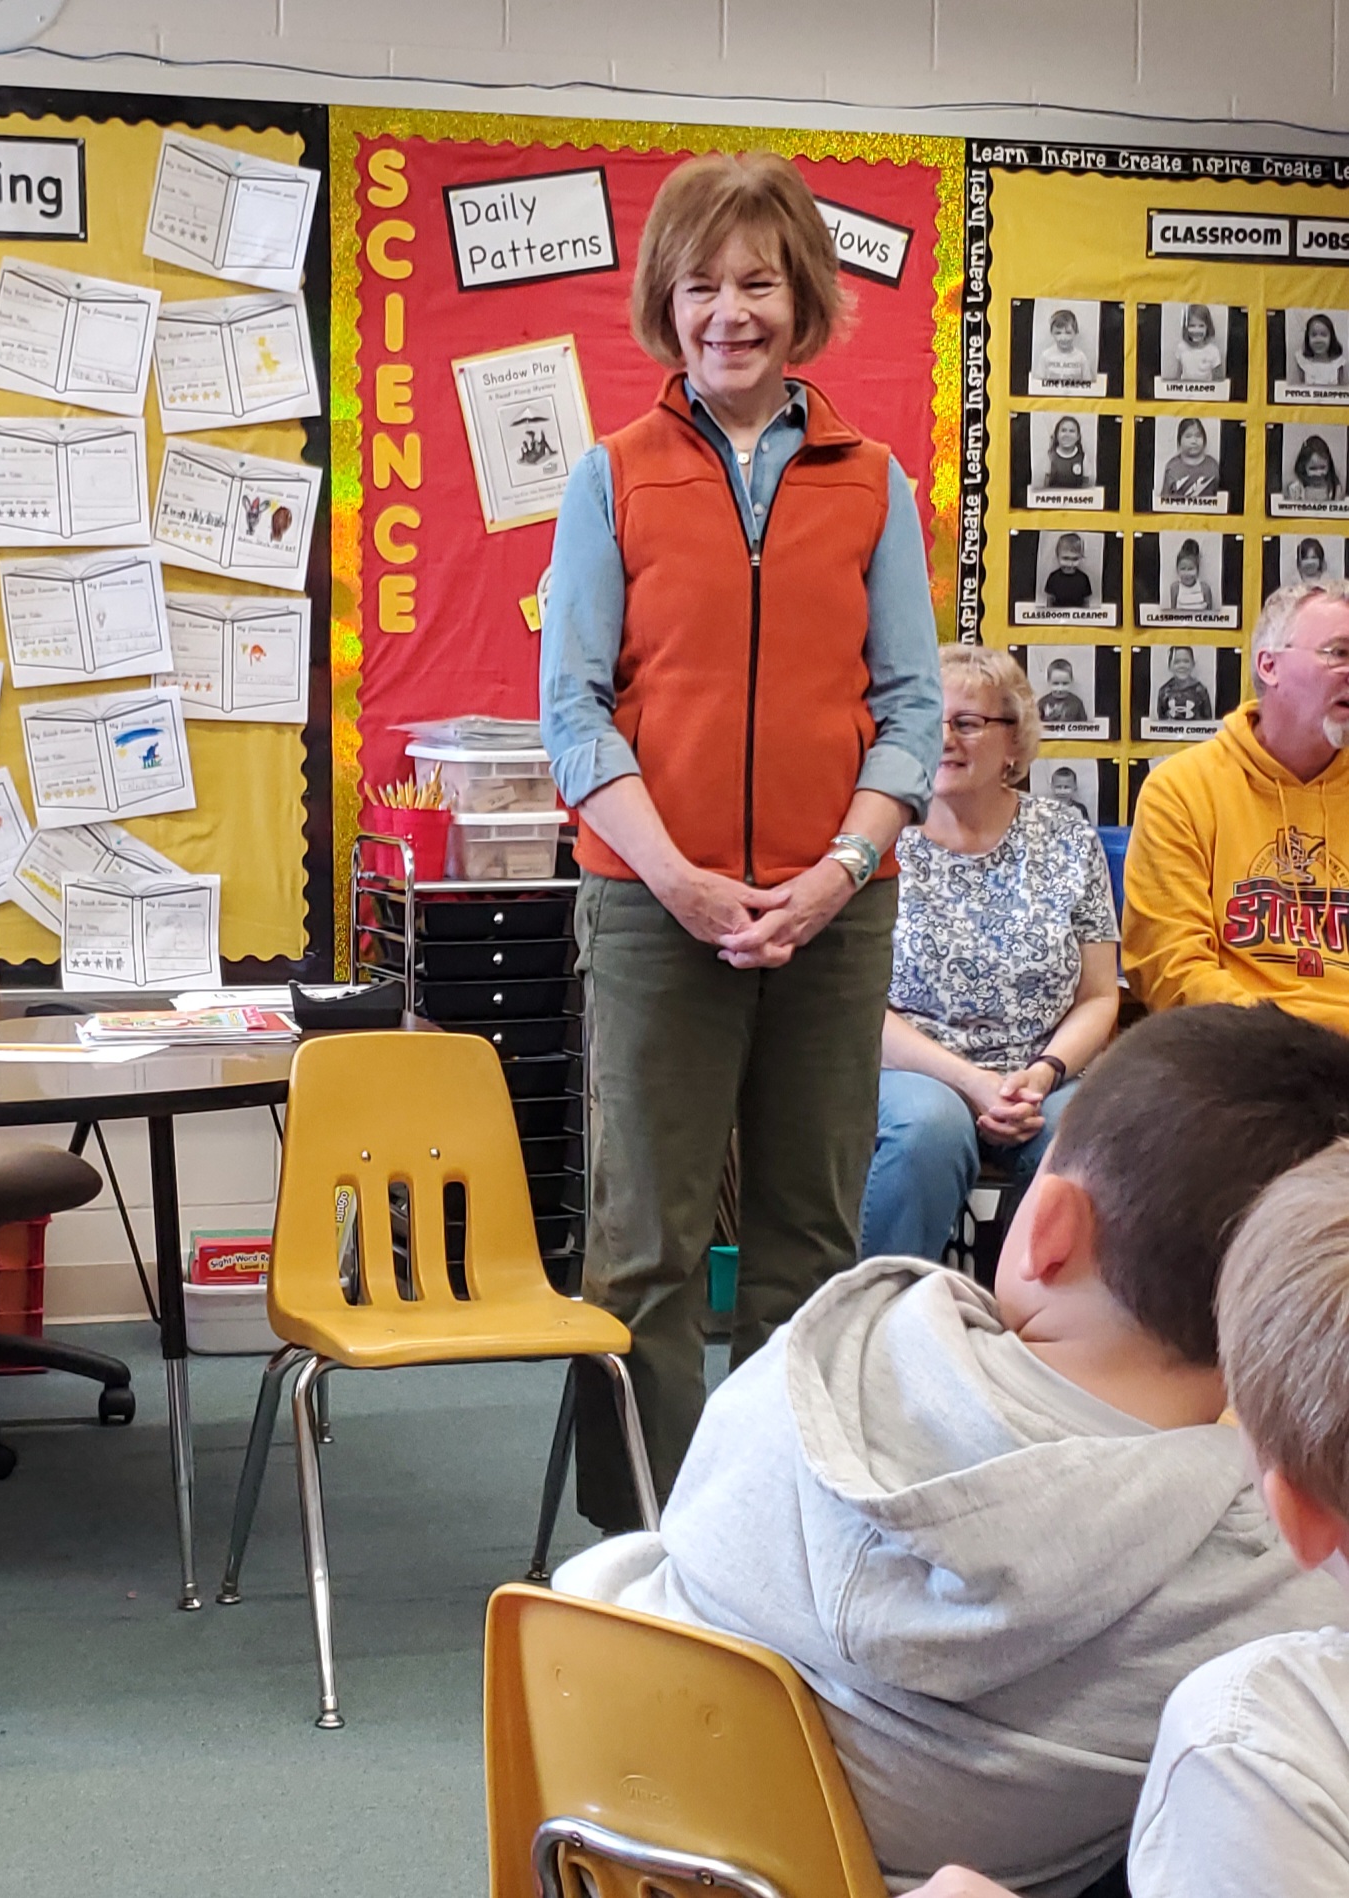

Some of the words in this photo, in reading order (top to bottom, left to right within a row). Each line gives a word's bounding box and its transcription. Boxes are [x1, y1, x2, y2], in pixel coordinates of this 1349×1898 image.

[971, 142, 1029, 164] Learn
[1041, 145, 1107, 168] Inspire
[1118, 150, 1182, 171] Create
[1262, 158, 1322, 178] Create
[459, 192, 536, 226] Daily
[468, 234, 602, 274] Patterns
[827, 219, 891, 263] dows
[1160, 225, 1282, 246] CLASSROOM
[967, 240, 984, 303] Learn
[365, 148, 423, 634] SCIENCE
[482, 365, 528, 387] Shadow
[532, 362, 557, 376] Play
[966, 335, 985, 410] Inspire
[964, 422, 982, 485] Learn
[961, 494, 979, 564] Create
